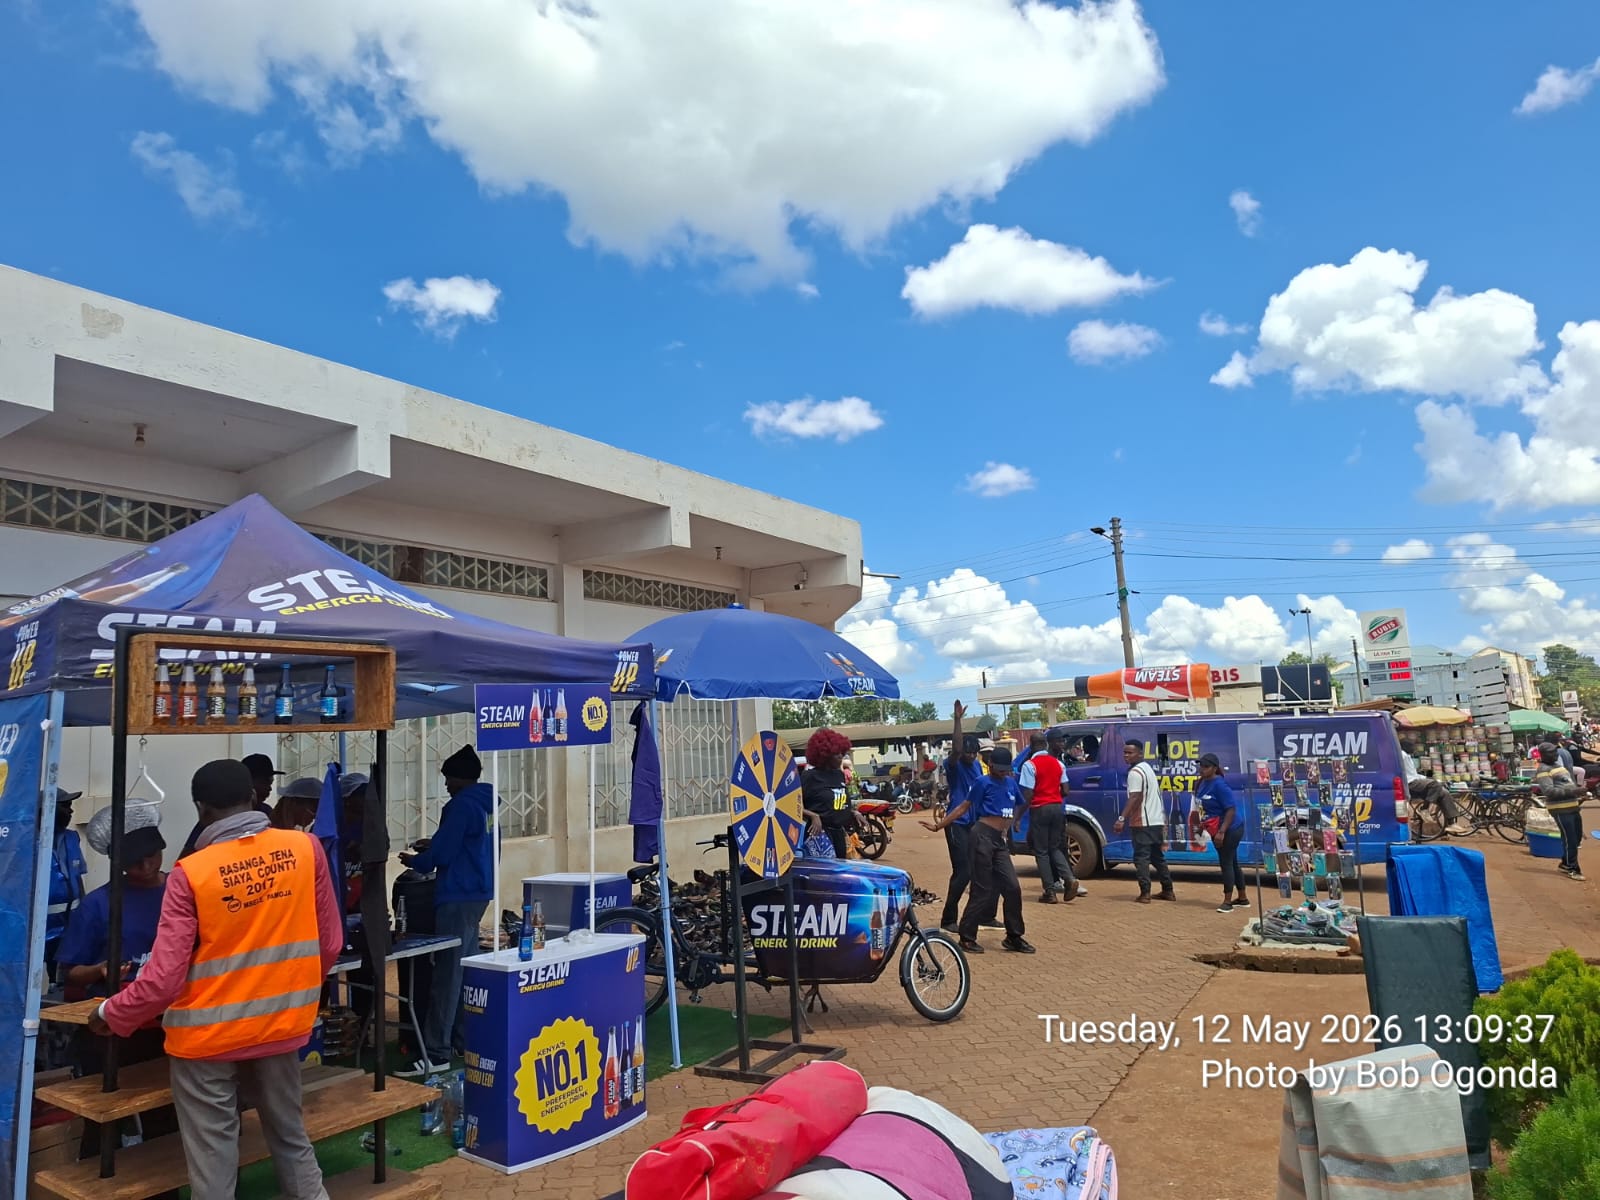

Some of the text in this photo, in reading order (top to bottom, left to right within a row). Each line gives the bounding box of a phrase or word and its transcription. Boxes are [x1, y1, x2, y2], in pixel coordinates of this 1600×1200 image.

[279, 594, 383, 616] ENERGY
[17, 620, 40, 643] POWER
[1371, 621, 1396, 638] RUBIS
[8, 639, 37, 691] UP
[618, 650, 640, 662] POWER
[610, 661, 639, 693] UP
[847, 677, 876, 691] STEAM
[1134, 668, 1181, 683] STEAM
[1210, 668, 1240, 683] BIS
[480, 705, 525, 722] STEAM
[1282, 731, 1368, 756] STEAM
[1156, 775, 1201, 793] AST
[1358, 822, 1381, 831] Game
[219, 848, 295, 877] RASANGA TENA
[222, 859, 297, 889] SIAYA COUNTY
[246, 877, 275, 896] 2017
[754, 937, 839, 949] ENER DRINK
[625, 947, 639, 973] UP
[517, 961, 571, 987] STEAM
[520, 978, 565, 994] ENERGY DRINK
[536, 1040, 566, 1057] KENYA'S
[480, 1057, 497, 1071] ENERGY
[534, 1039, 588, 1101] NO.1
[540, 1090, 589, 1118] ENERGY DRINK
[545, 1085, 584, 1107] PREFERRED
[466, 1123, 478, 1149] UP
